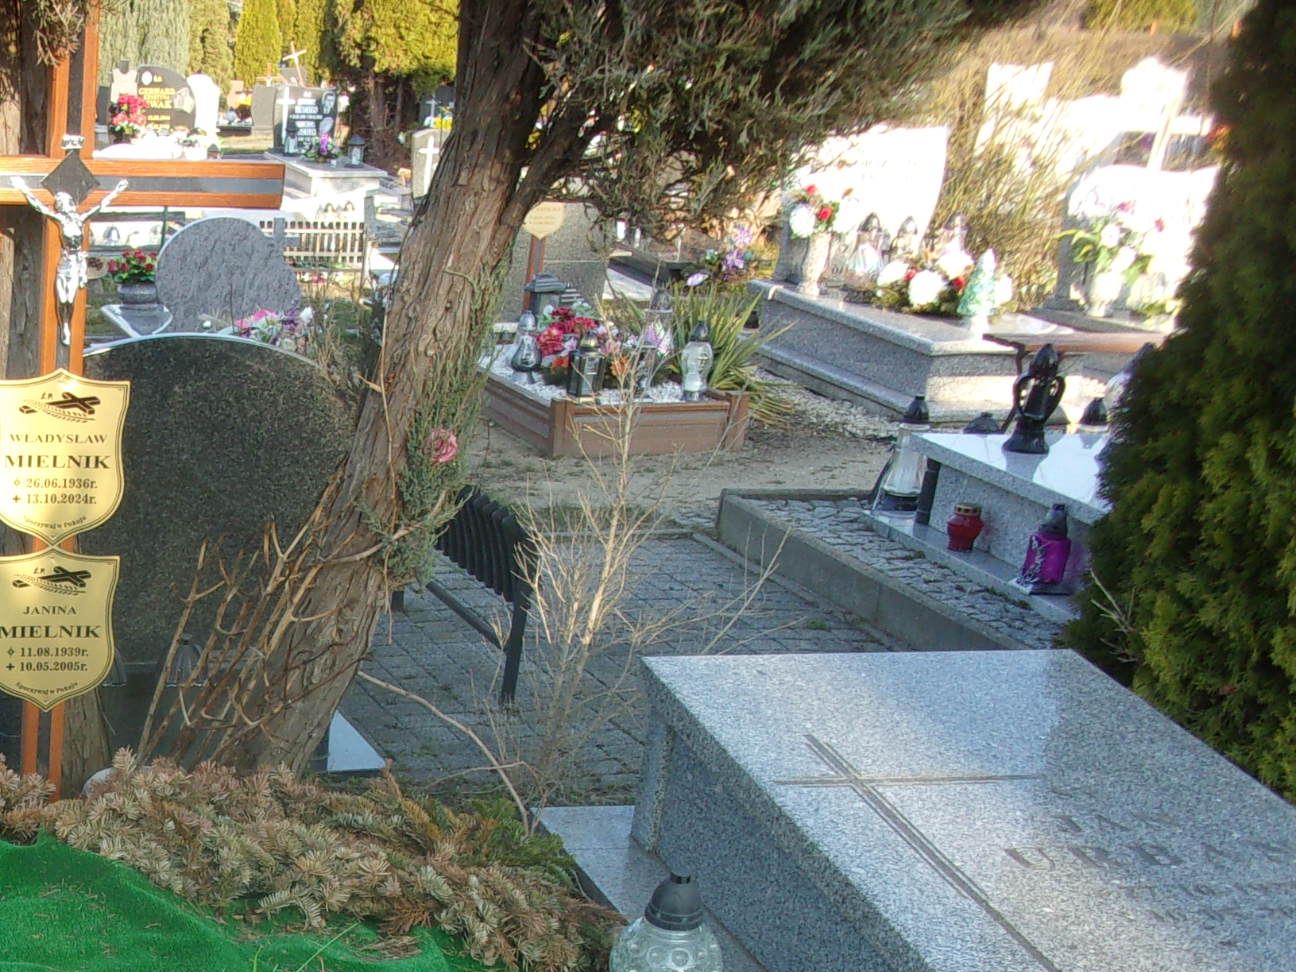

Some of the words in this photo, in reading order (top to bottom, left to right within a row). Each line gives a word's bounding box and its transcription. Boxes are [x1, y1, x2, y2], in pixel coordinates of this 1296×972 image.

[5, 454, 112, 470] MIELNIK
[25, 478, 98, 489] 26.06.1936r.
[26, 494, 97, 505] 13.10.2024r.
[22, 605, 78, 616] JANINA
[20, 647, 89, 657] 11.08.1939r.
[19, 662, 88, 672] 10.05.2005r.
